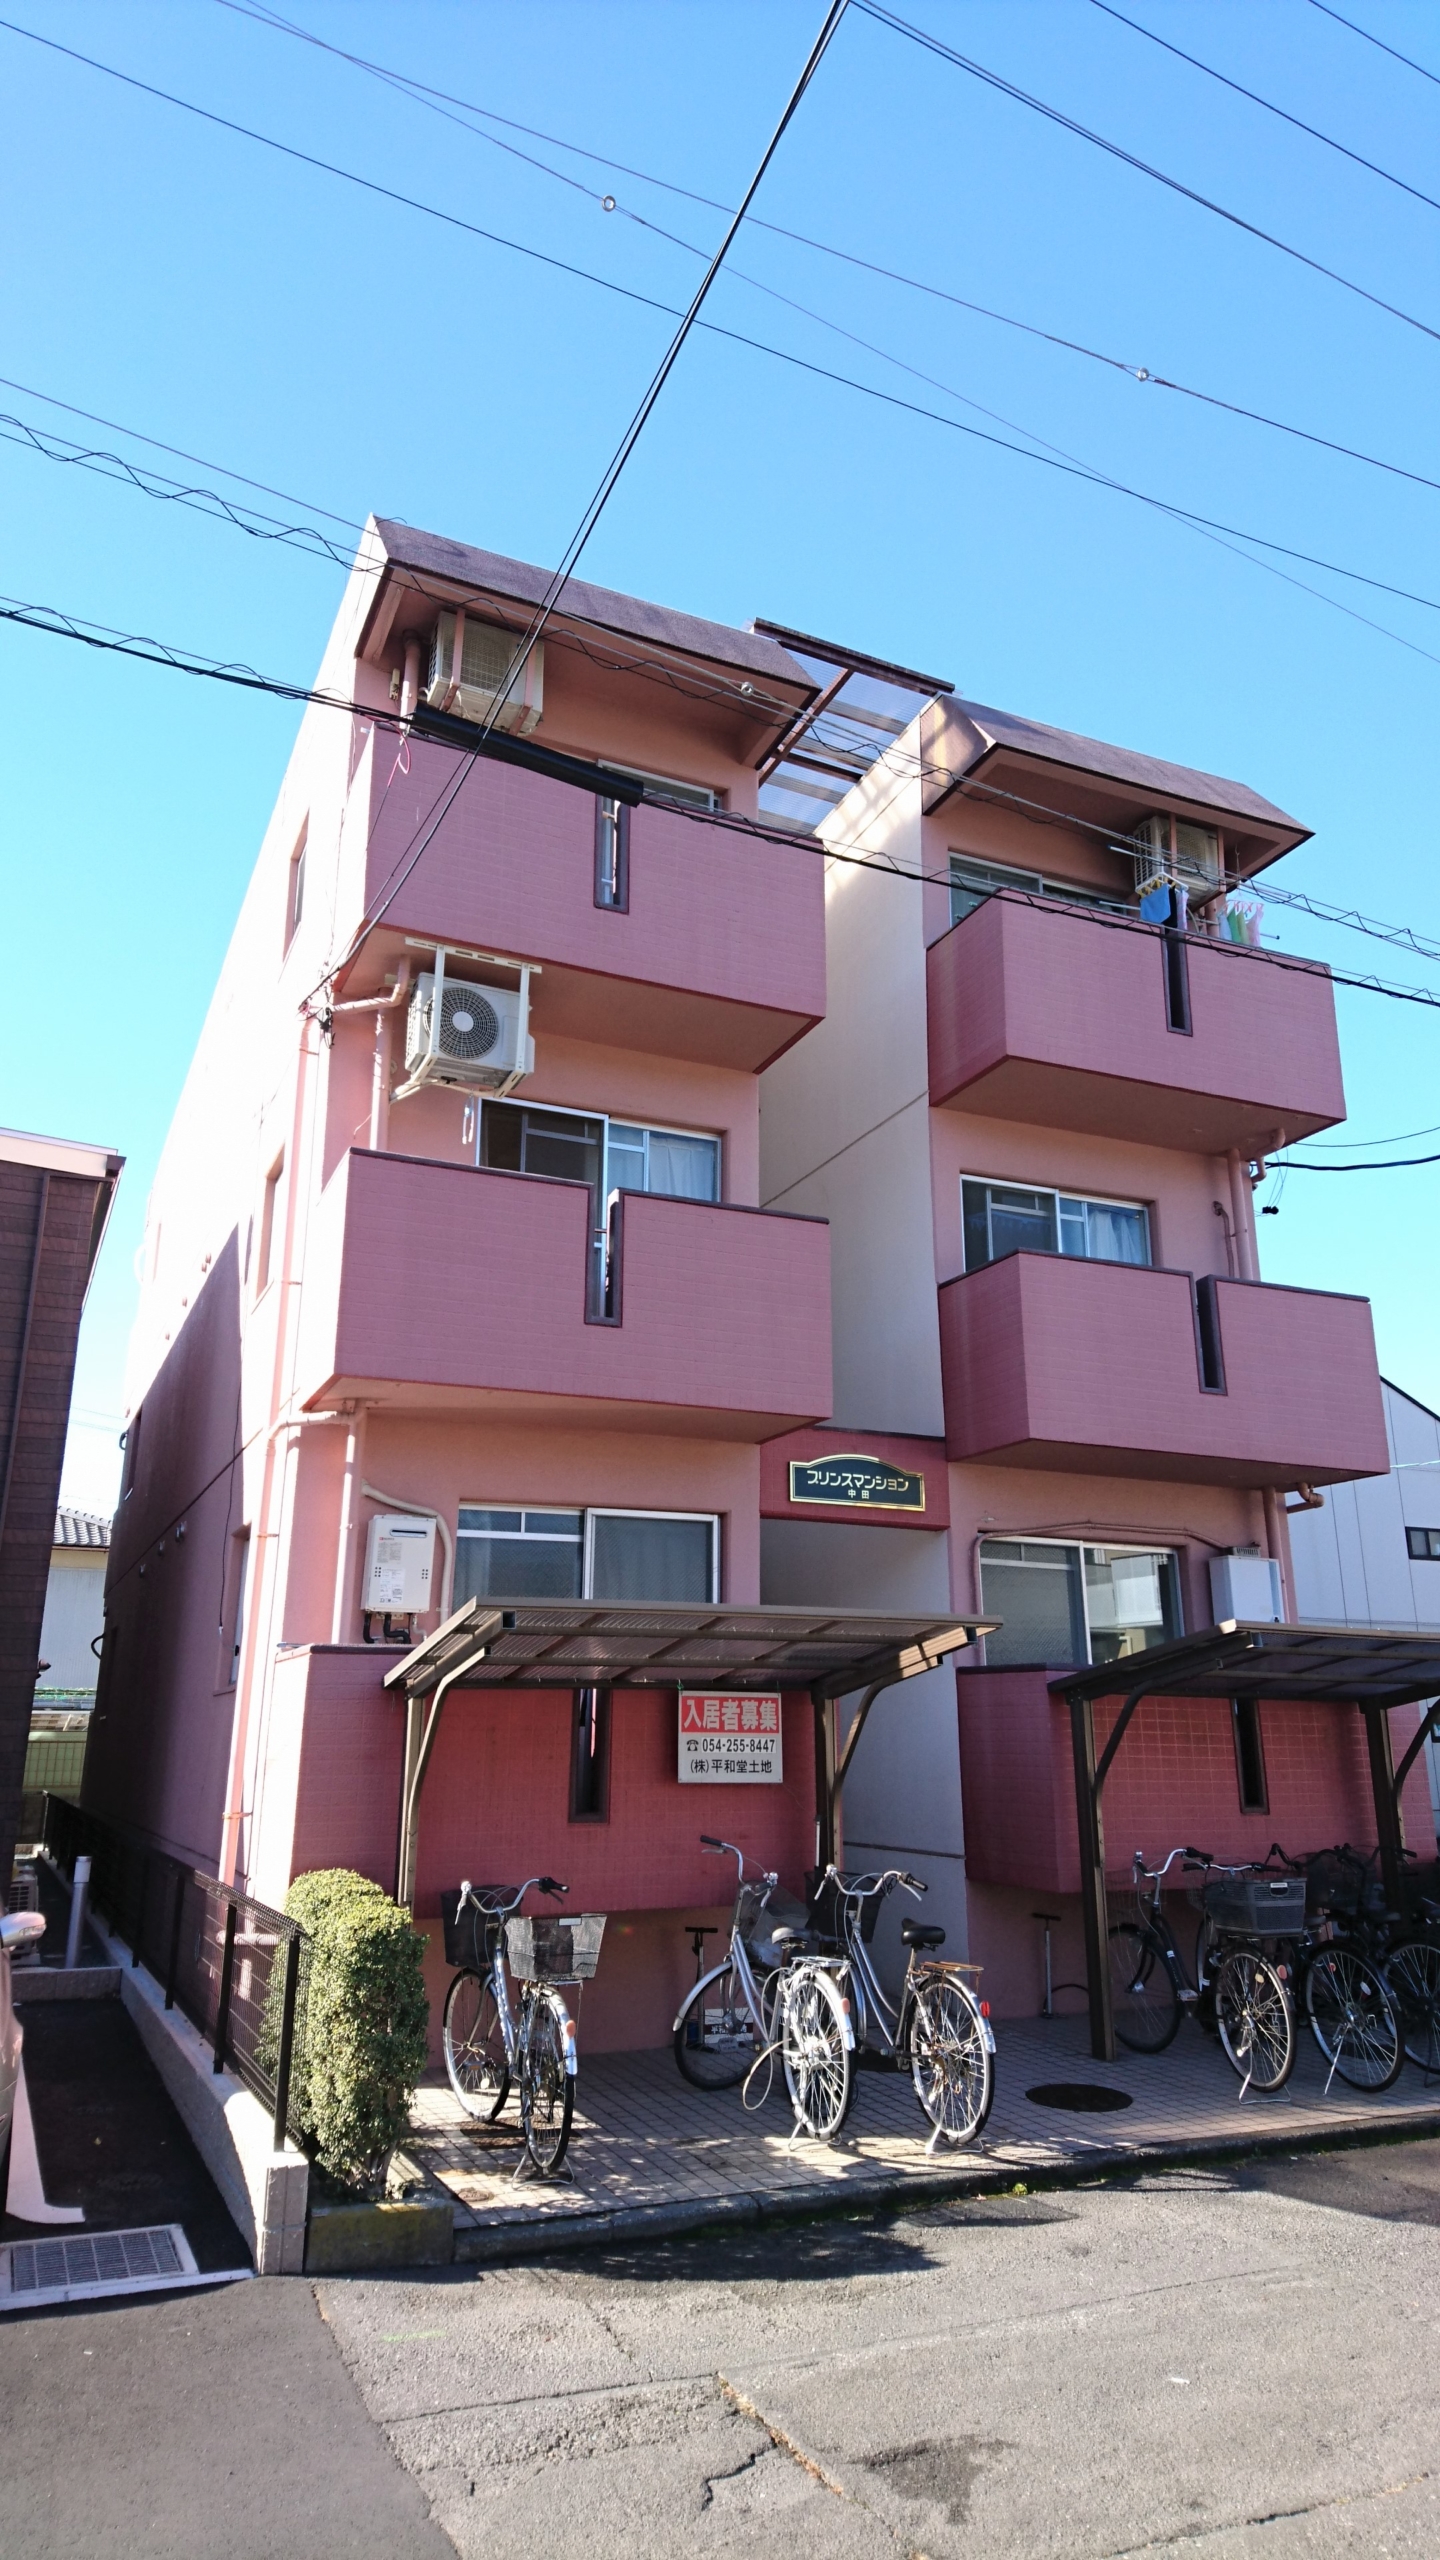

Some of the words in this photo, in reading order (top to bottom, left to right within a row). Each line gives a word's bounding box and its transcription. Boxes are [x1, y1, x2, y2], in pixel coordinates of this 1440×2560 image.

[807, 1470, 909, 1491] プリンスマンション
[685, 1699, 777, 1731] 入居者募集
[690, 1759, 772, 1774] (株)平和堂土地
